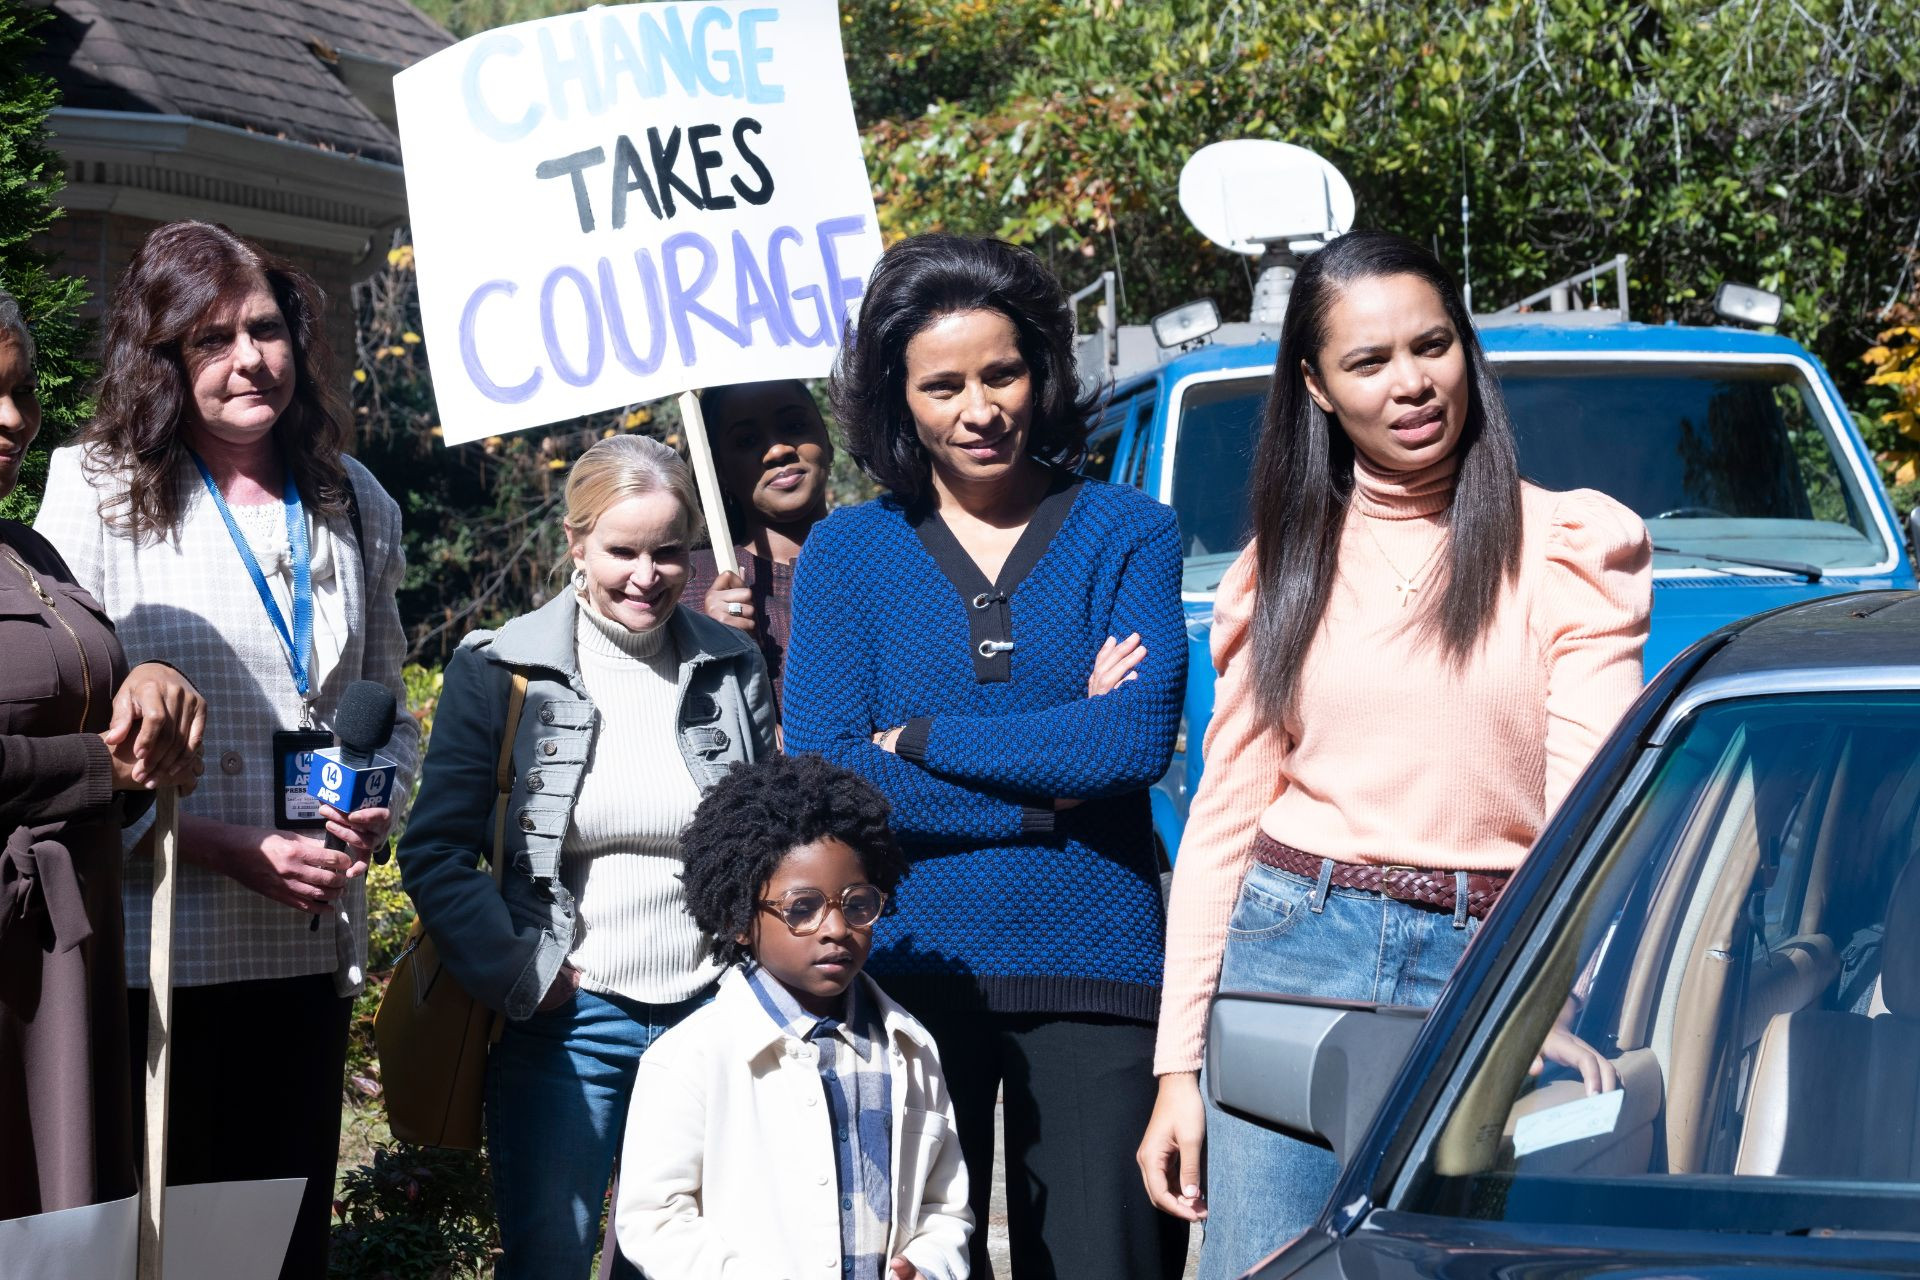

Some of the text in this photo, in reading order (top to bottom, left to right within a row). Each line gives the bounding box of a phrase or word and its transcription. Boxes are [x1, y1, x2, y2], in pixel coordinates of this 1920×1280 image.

[461, 5, 786, 142] CHANGE
[535, 117, 775, 234] TAKES
[458, 214, 867, 405] COURAGE
[316, 787, 341, 804] ARP
[326, 766, 338, 785] 14
[369, 774, 382, 791] 14
